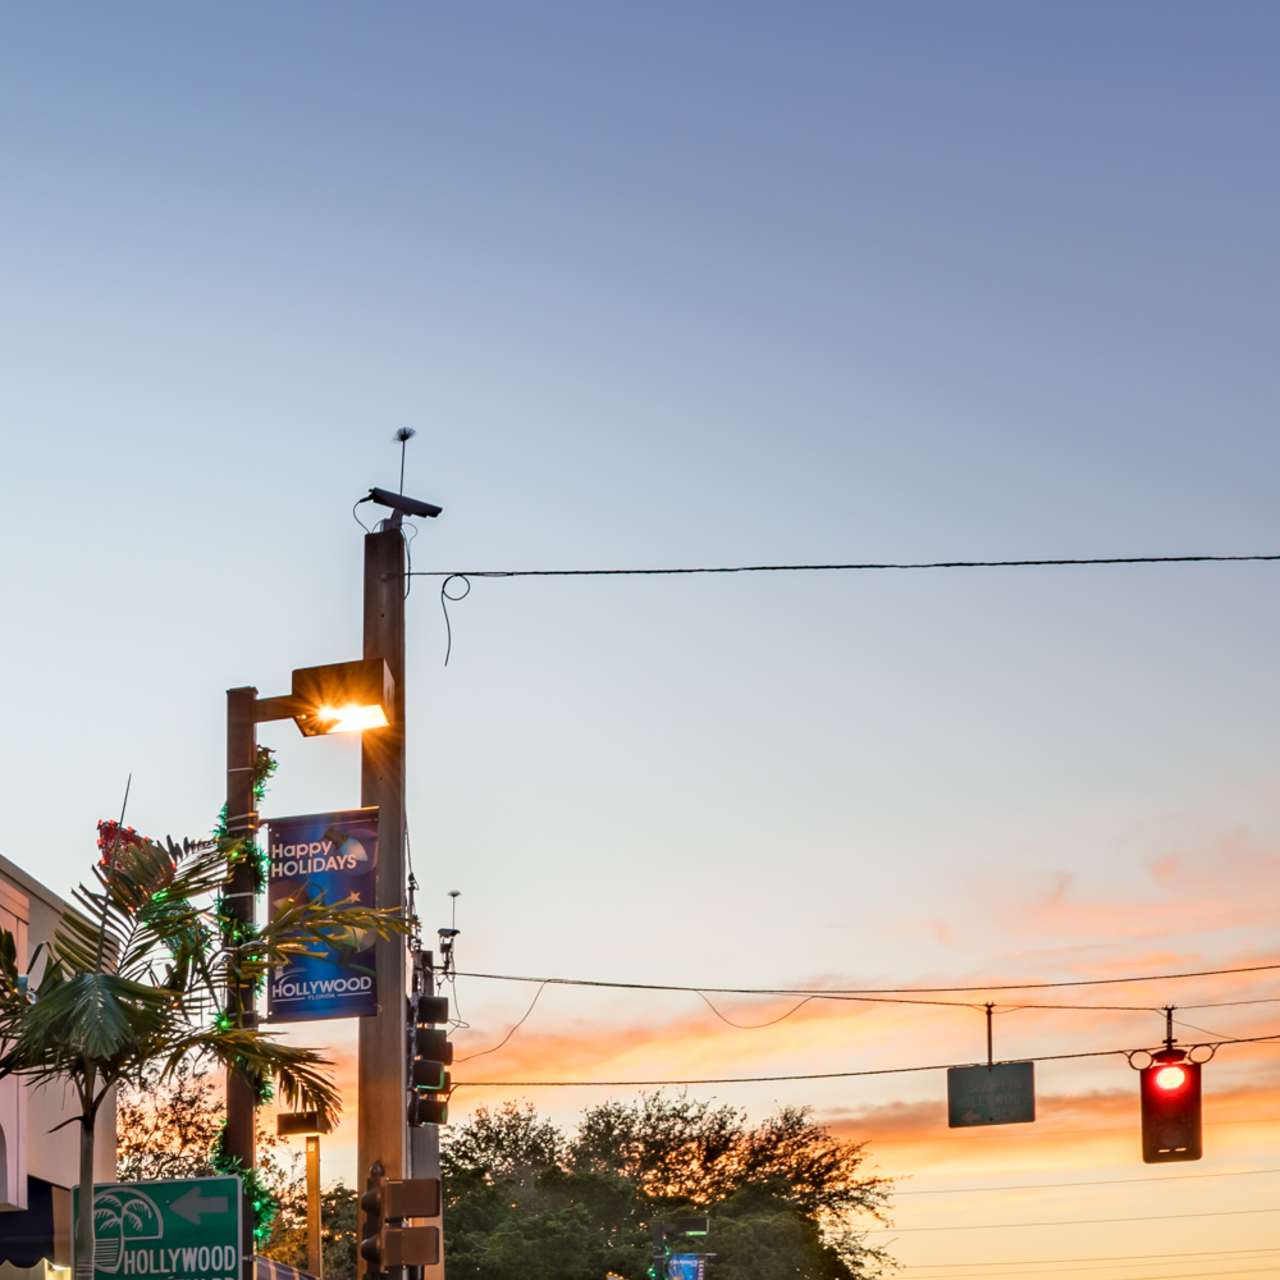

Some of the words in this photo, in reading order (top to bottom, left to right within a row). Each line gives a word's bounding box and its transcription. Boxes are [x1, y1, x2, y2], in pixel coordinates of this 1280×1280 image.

[271, 840, 333, 859] Happy
[271, 854, 358, 878] HOLIDAYS
[271, 976, 372, 998] HOLLYWOOD
[123, 1245, 237, 1275] HOLLYWOOD
